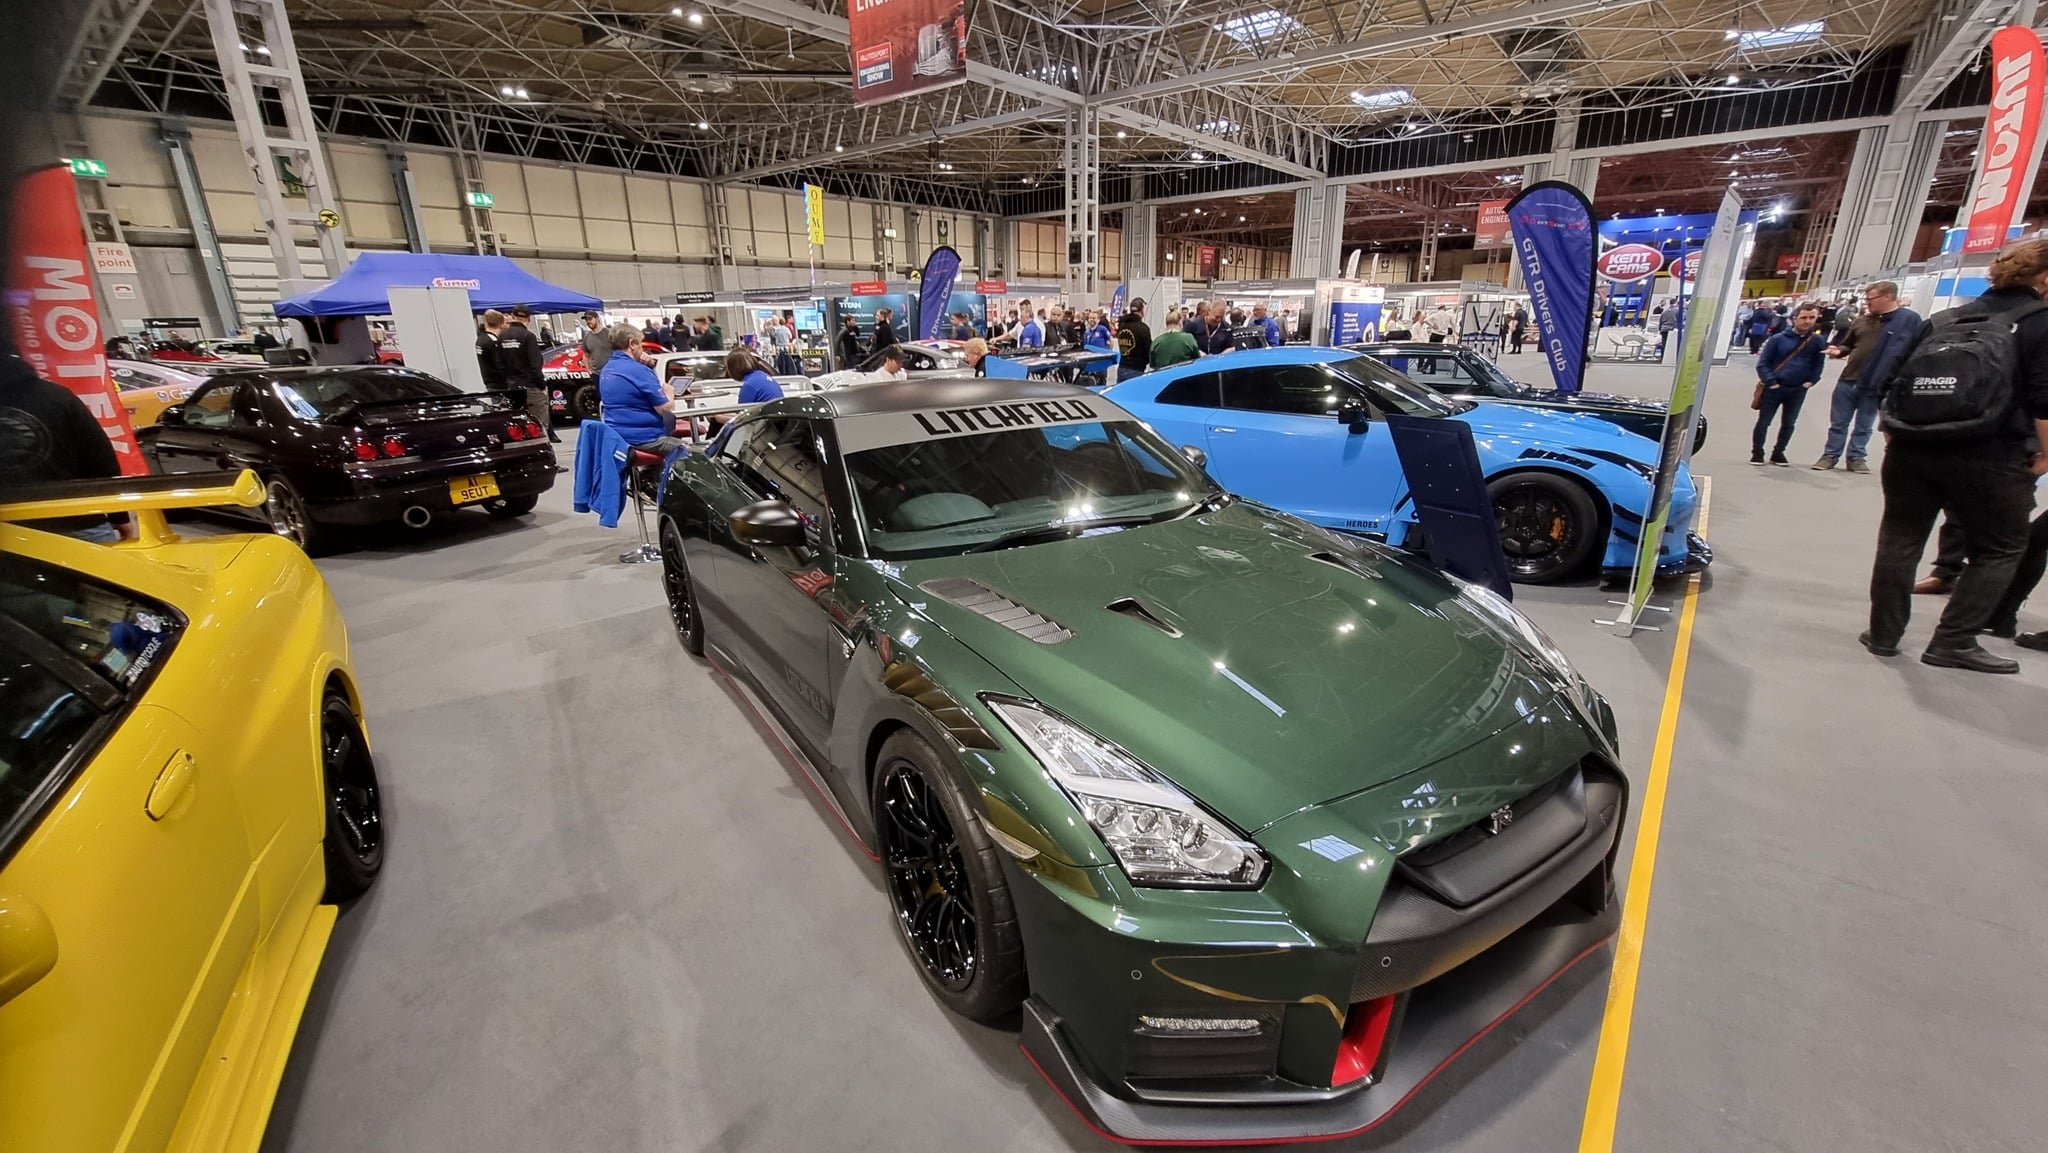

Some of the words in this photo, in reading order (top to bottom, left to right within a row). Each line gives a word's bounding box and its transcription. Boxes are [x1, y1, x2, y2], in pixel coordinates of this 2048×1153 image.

[867, 71, 884, 82] SHOW
[97, 247, 124, 256] Fire
[1609, 252, 1652, 264] KENT
[98, 259, 132, 268] point
[1606, 263, 1651, 275] CAMS
[838, 301, 861, 309] TITAN
[1522, 237, 1541, 277] GTR
[1533, 279, 1555, 335] Drivers
[1550, 338, 1568, 372] Club
[1924, 377, 1957, 385] PAGID
[912, 400, 1098, 435] LITCHFIELD
[1346, 520, 1379, 529] HEROES
